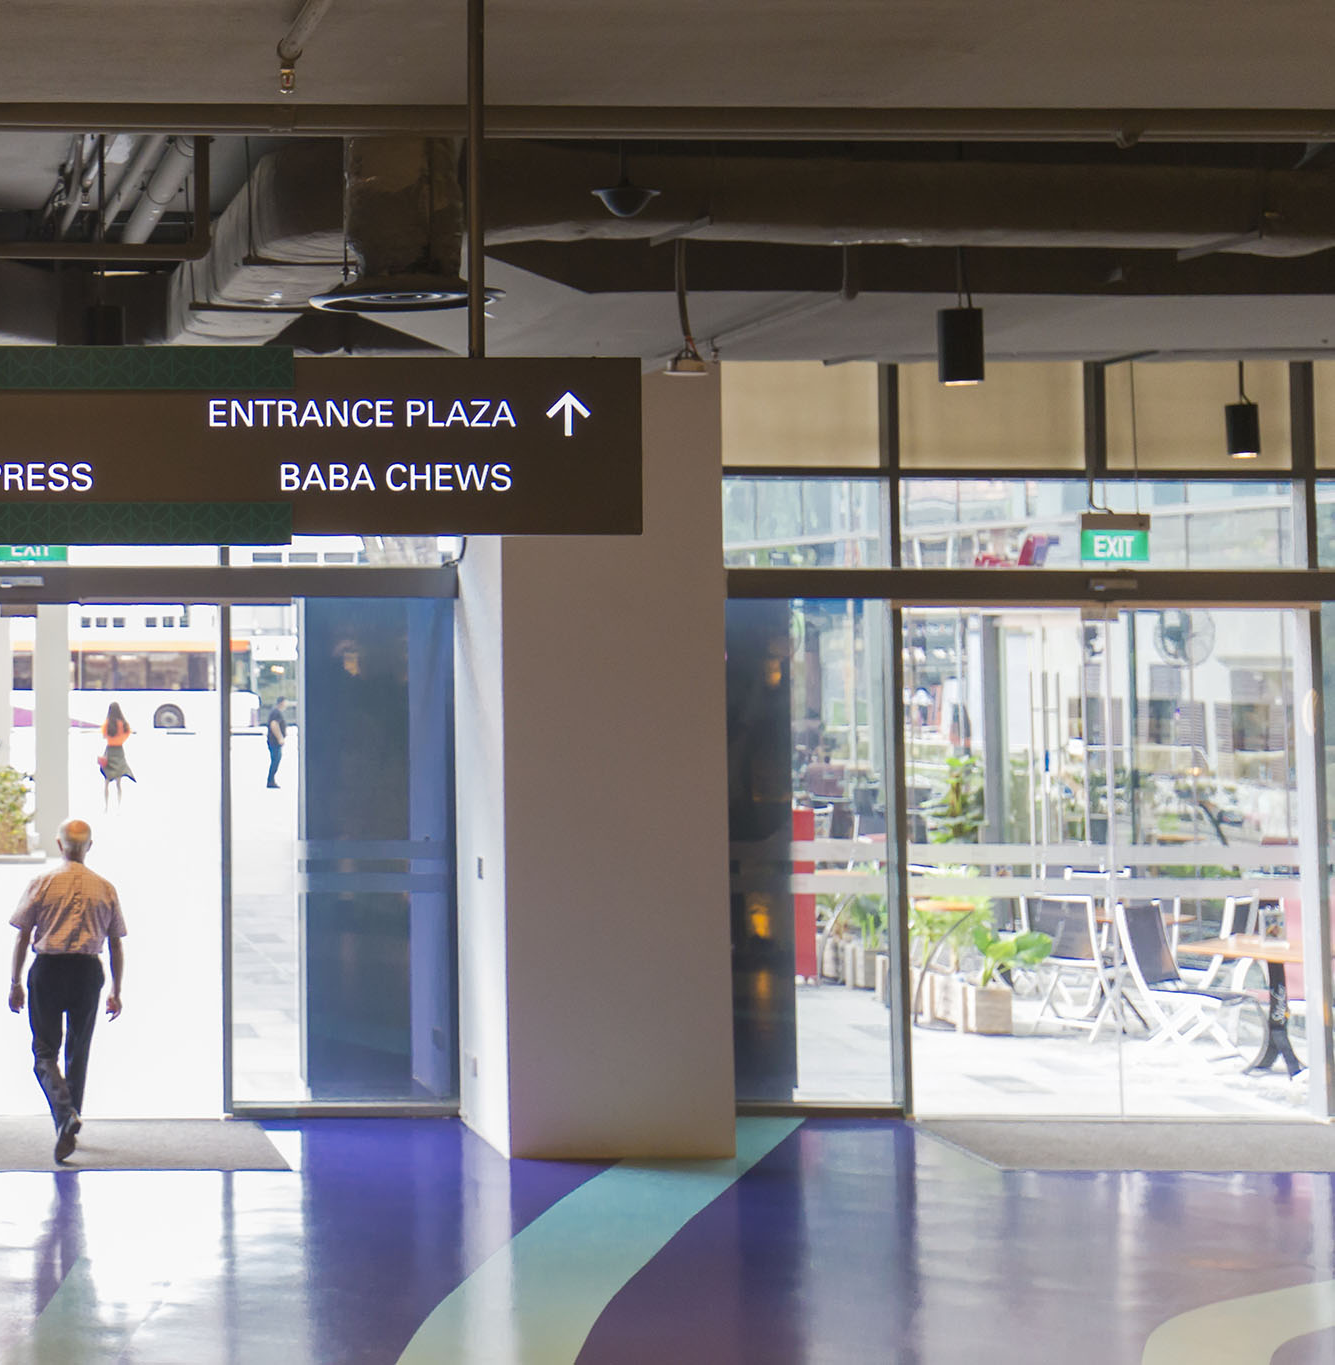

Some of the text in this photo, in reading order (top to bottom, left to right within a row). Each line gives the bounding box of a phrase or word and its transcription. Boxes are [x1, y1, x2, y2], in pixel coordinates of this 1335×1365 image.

[208, 400, 517, 428] ENTRANCE PLAZA
[280, 463, 512, 492] BABA CHEWS
[1093, 535, 1135, 558] EXIT
